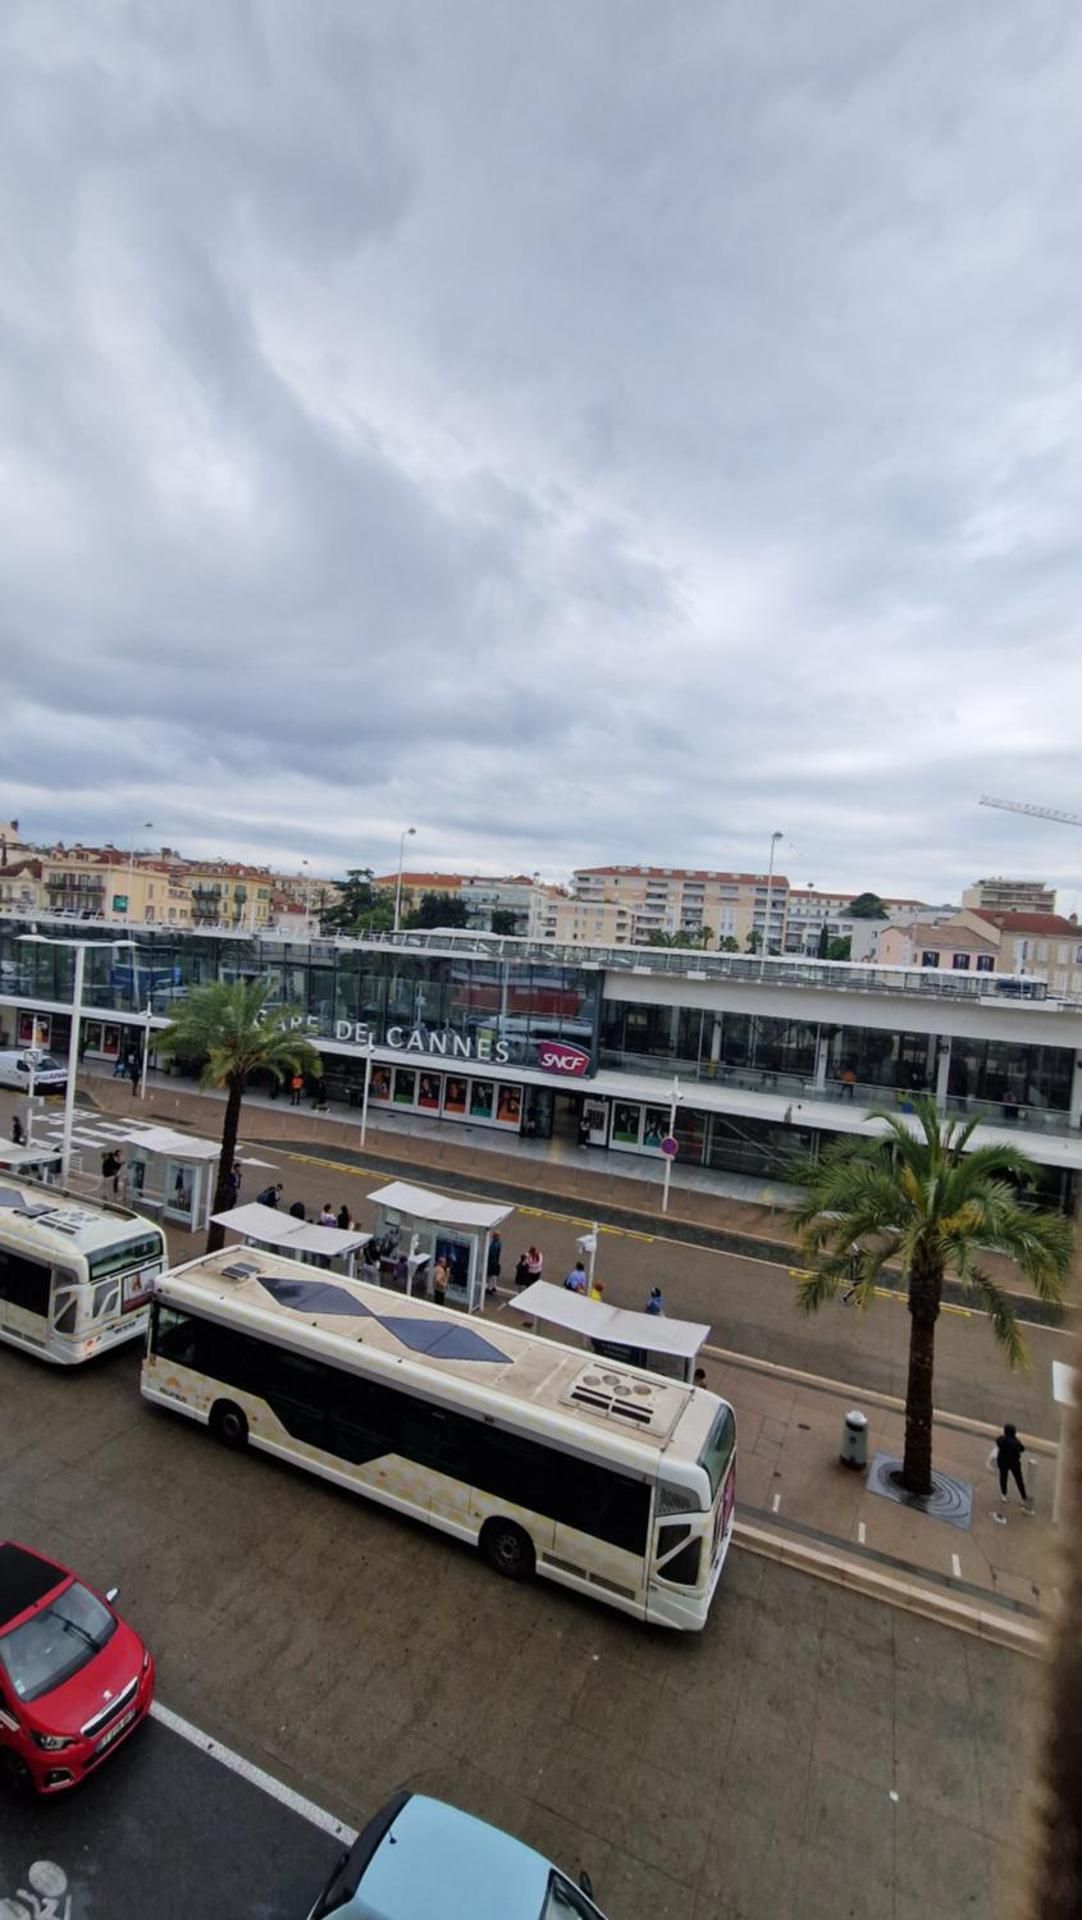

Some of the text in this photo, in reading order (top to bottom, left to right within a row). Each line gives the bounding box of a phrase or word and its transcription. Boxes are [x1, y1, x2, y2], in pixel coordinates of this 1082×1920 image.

[335, 1019, 368, 1043] DE
[387, 1026, 510, 1064] CANNES
[541, 1052, 585, 1071] SNCF
